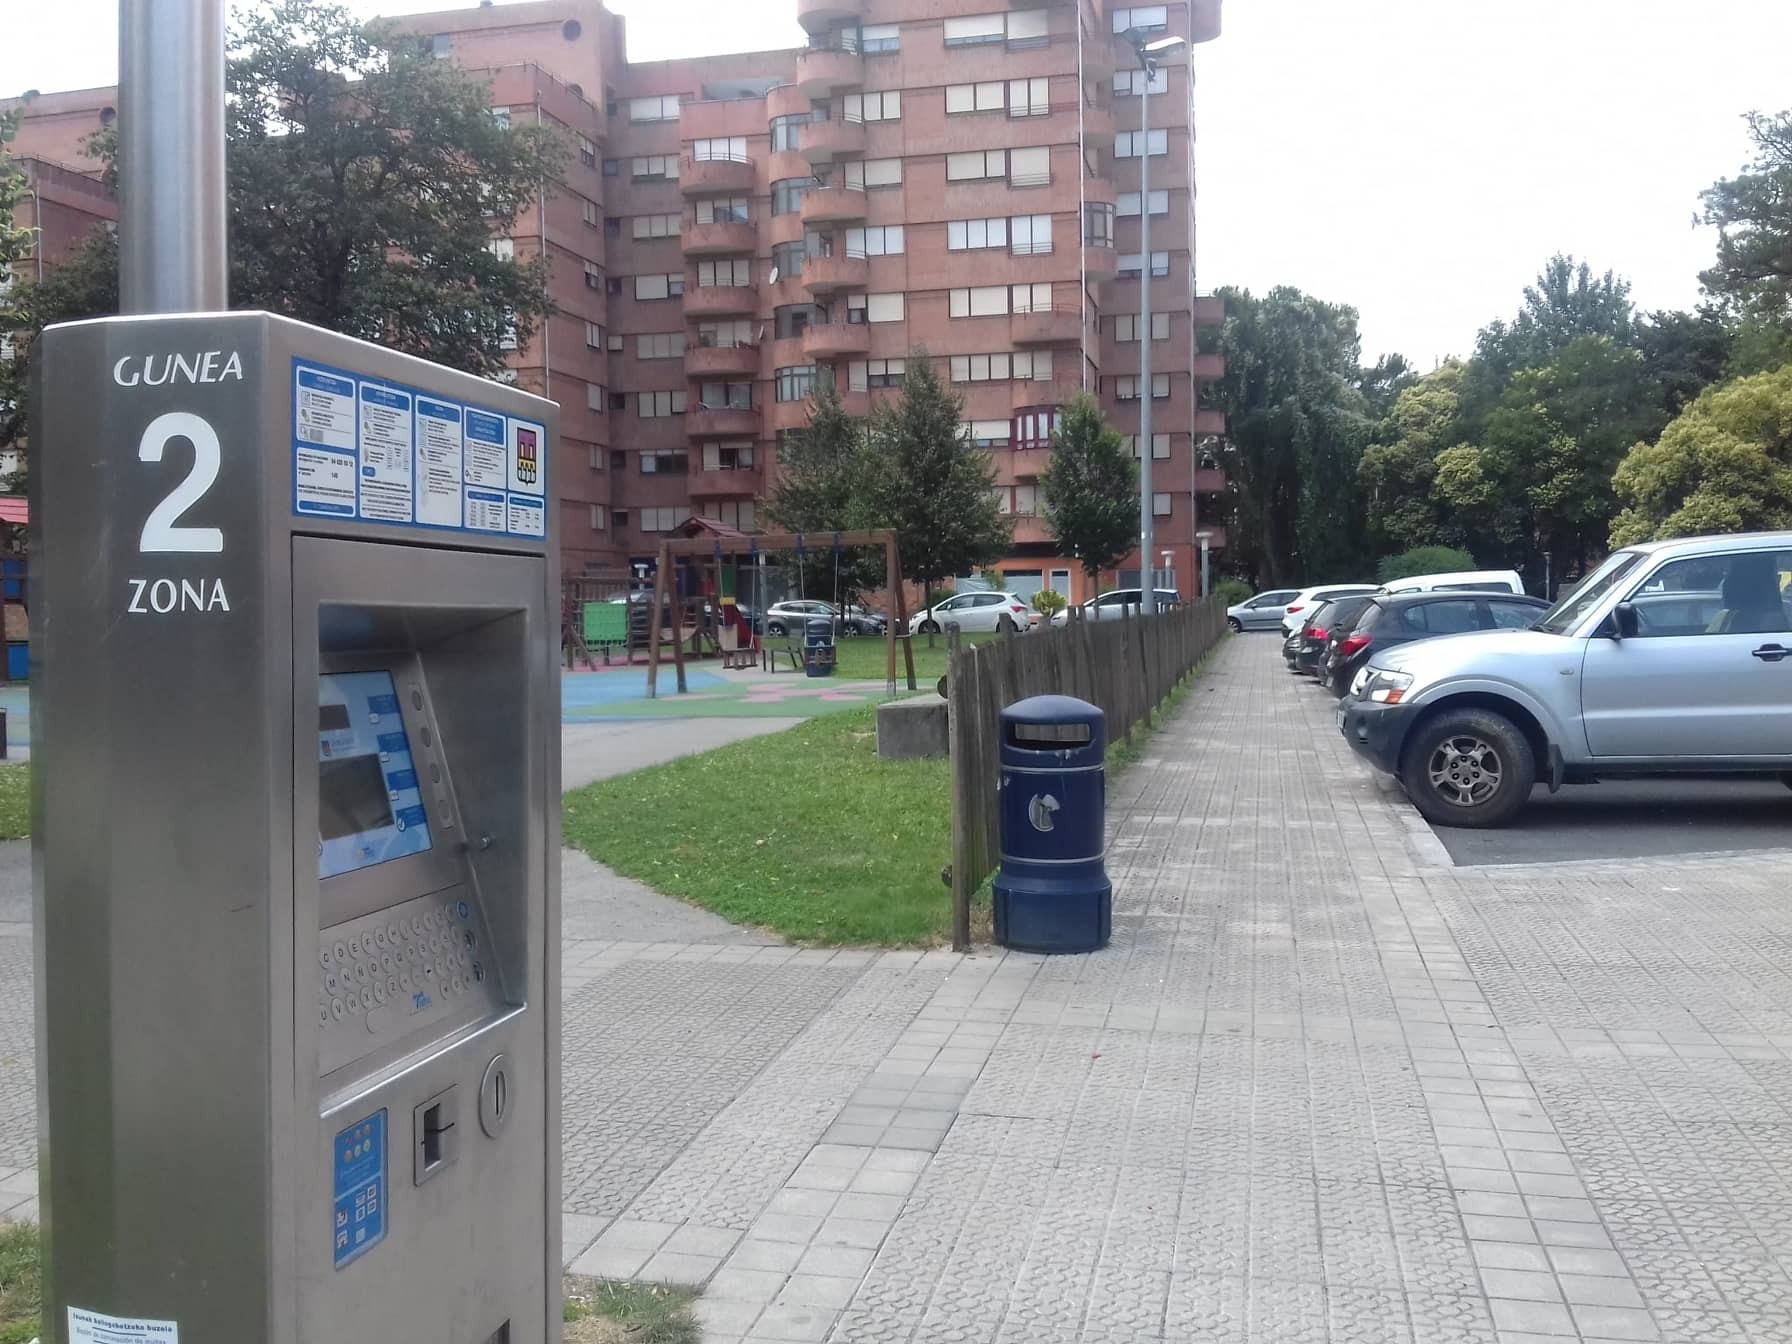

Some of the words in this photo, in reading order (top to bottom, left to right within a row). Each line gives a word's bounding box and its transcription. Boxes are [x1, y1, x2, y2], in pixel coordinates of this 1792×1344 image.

[113, 351, 243, 386] GUNEA
[138, 412, 223, 552] 2
[128, 578, 230, 613] ZONA
